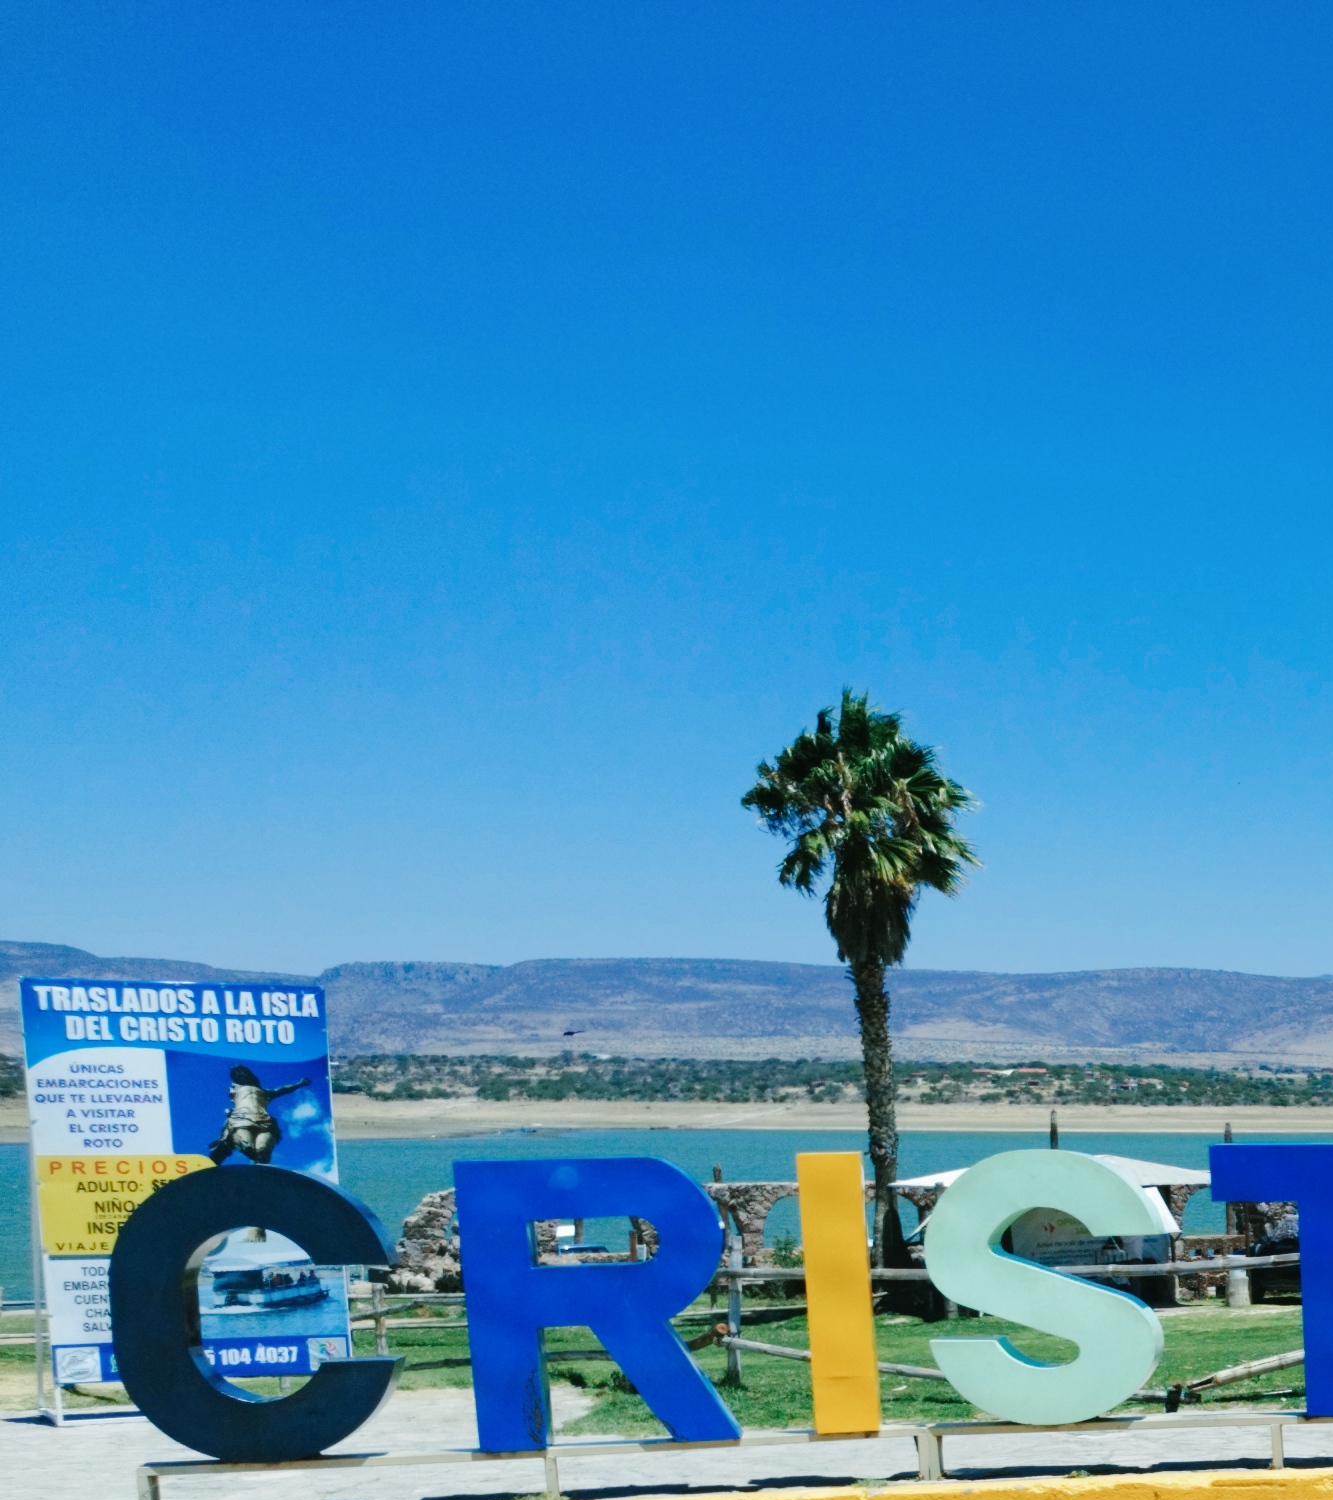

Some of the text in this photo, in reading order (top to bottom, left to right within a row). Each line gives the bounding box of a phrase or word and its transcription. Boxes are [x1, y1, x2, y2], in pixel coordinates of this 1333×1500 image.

[32, 985, 319, 1018] TRASLADOS A LA ISLA
[65, 1015, 295, 1045] DEL CRISTO ROTO
[69, 1061, 124, 1074] ÚNICAS
[36, 1078, 159, 1089] EMBARCACIONES
[34, 1092, 163, 1104] QUE TE LLEVARÁN
[66, 1109, 136, 1118] A VISITAR
[69, 1123, 139, 1133] EL CRISTO
[83, 1138, 124, 1148] ROTO
[76, 1181, 144, 1193] ADULTO:
[56, 1242, 109, 1251] VIAJE
[81, 1266, 109, 1276] TOD
[63, 1281, 109, 1291] EMBAR
[85, 1308, 111, 1318] CHA
[83, 1322, 112, 1332] SALV
[219, 1348, 252, 1365] 104
[255, 1346, 298, 1363] 4037
